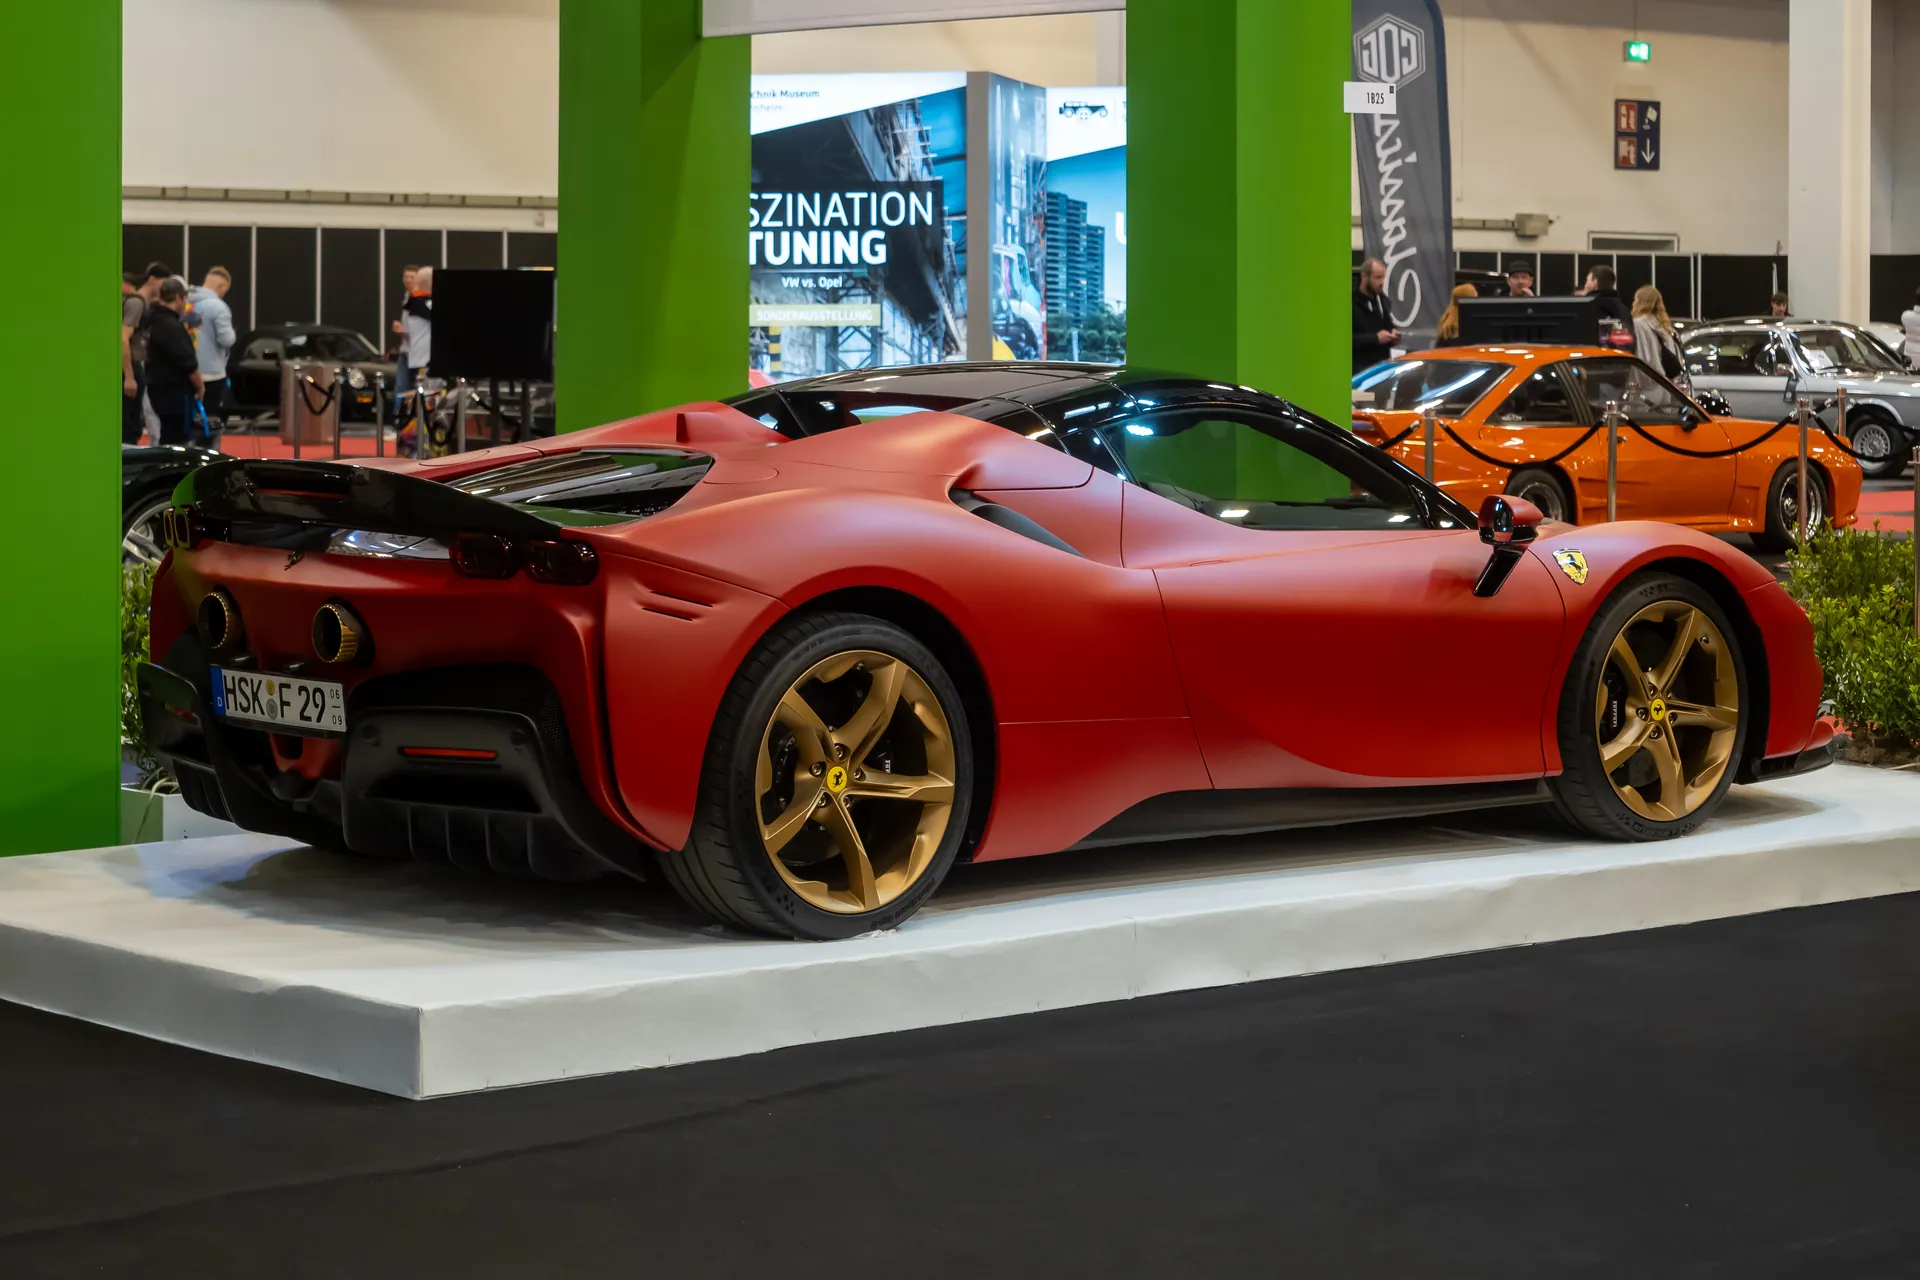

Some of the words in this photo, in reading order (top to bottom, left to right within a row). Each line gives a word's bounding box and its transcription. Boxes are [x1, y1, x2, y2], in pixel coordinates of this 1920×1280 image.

[780, 90, 820, 98] Museum
[1367, 92, 1385, 105] 1B25
[749, 229, 887, 266] TUNING
[781, 277, 799, 288] VW
[801, 278, 817, 288] vs.
[818, 276, 843, 290] Opel
[756, 310, 873, 322] SONDERAUSSTELLUNG
[223, 675, 265, 715] HSK
[278, 683, 292, 718] F
[297, 685, 326, 723] 29
[329, 688, 340, 700] 06
[332, 714, 343, 726] 09
